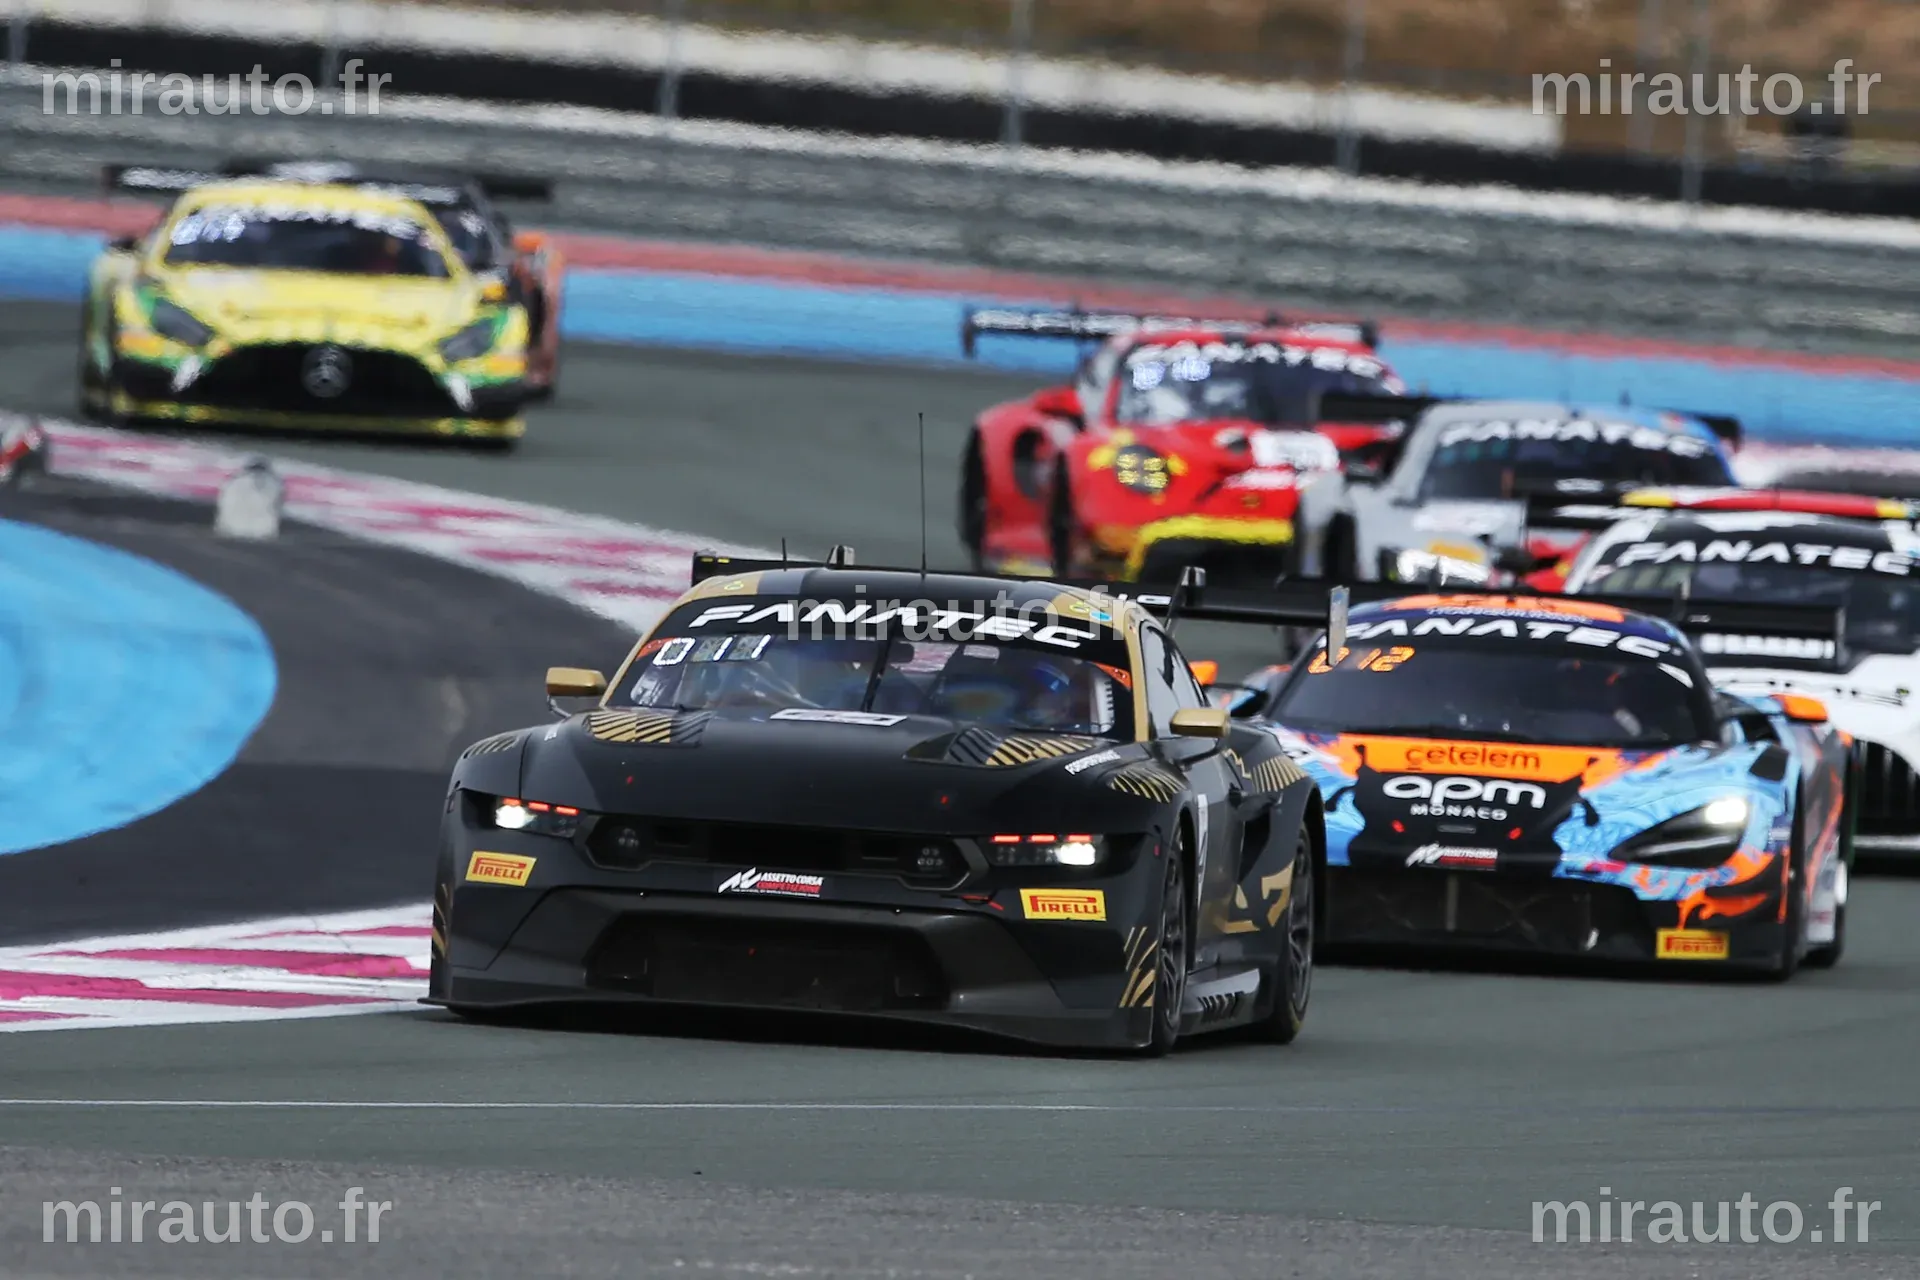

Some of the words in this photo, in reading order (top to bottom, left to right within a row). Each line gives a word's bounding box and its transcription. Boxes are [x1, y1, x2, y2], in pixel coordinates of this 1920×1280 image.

[1616, 540, 1914, 576] FANATEC
[688, 603, 1097, 649] FANATEC
[1317, 617, 1672, 659] FANATEC
[1405, 743, 1541, 771] cetelem
[1382, 775, 1546, 809] apm
[1410, 803, 1508, 821] MONACO
[472, 856, 527, 880] PIRELLI
[760, 872, 797, 884] ASSETTO
[1029, 895, 1098, 914] PIRELLI
